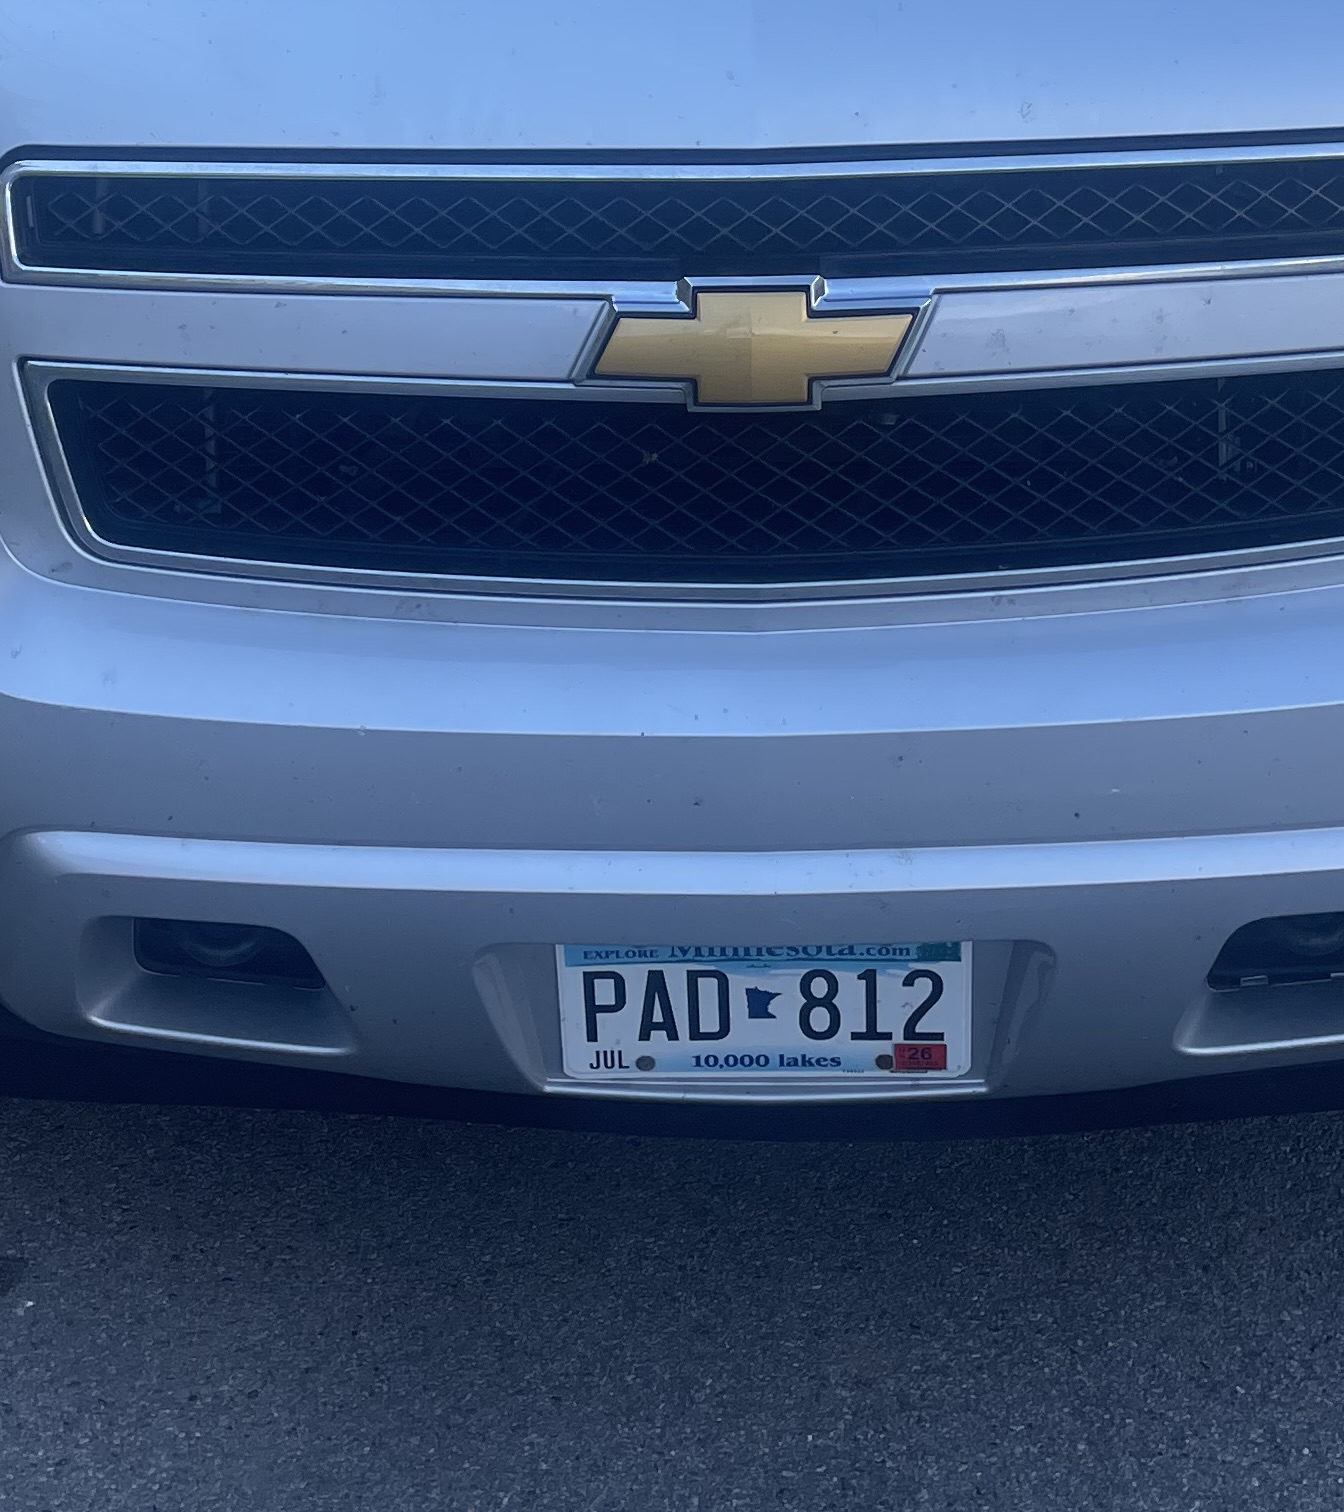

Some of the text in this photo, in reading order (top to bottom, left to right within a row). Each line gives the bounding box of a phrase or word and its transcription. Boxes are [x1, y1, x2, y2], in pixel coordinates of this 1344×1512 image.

[583, 949, 660, 960] EXPLORE
[582, 968, 945, 1043] PAD 812
[589, 1050, 630, 1070] JUL
[691, 1053, 770, 1069] 10,000
[778, 1052, 842, 1069] lakes
